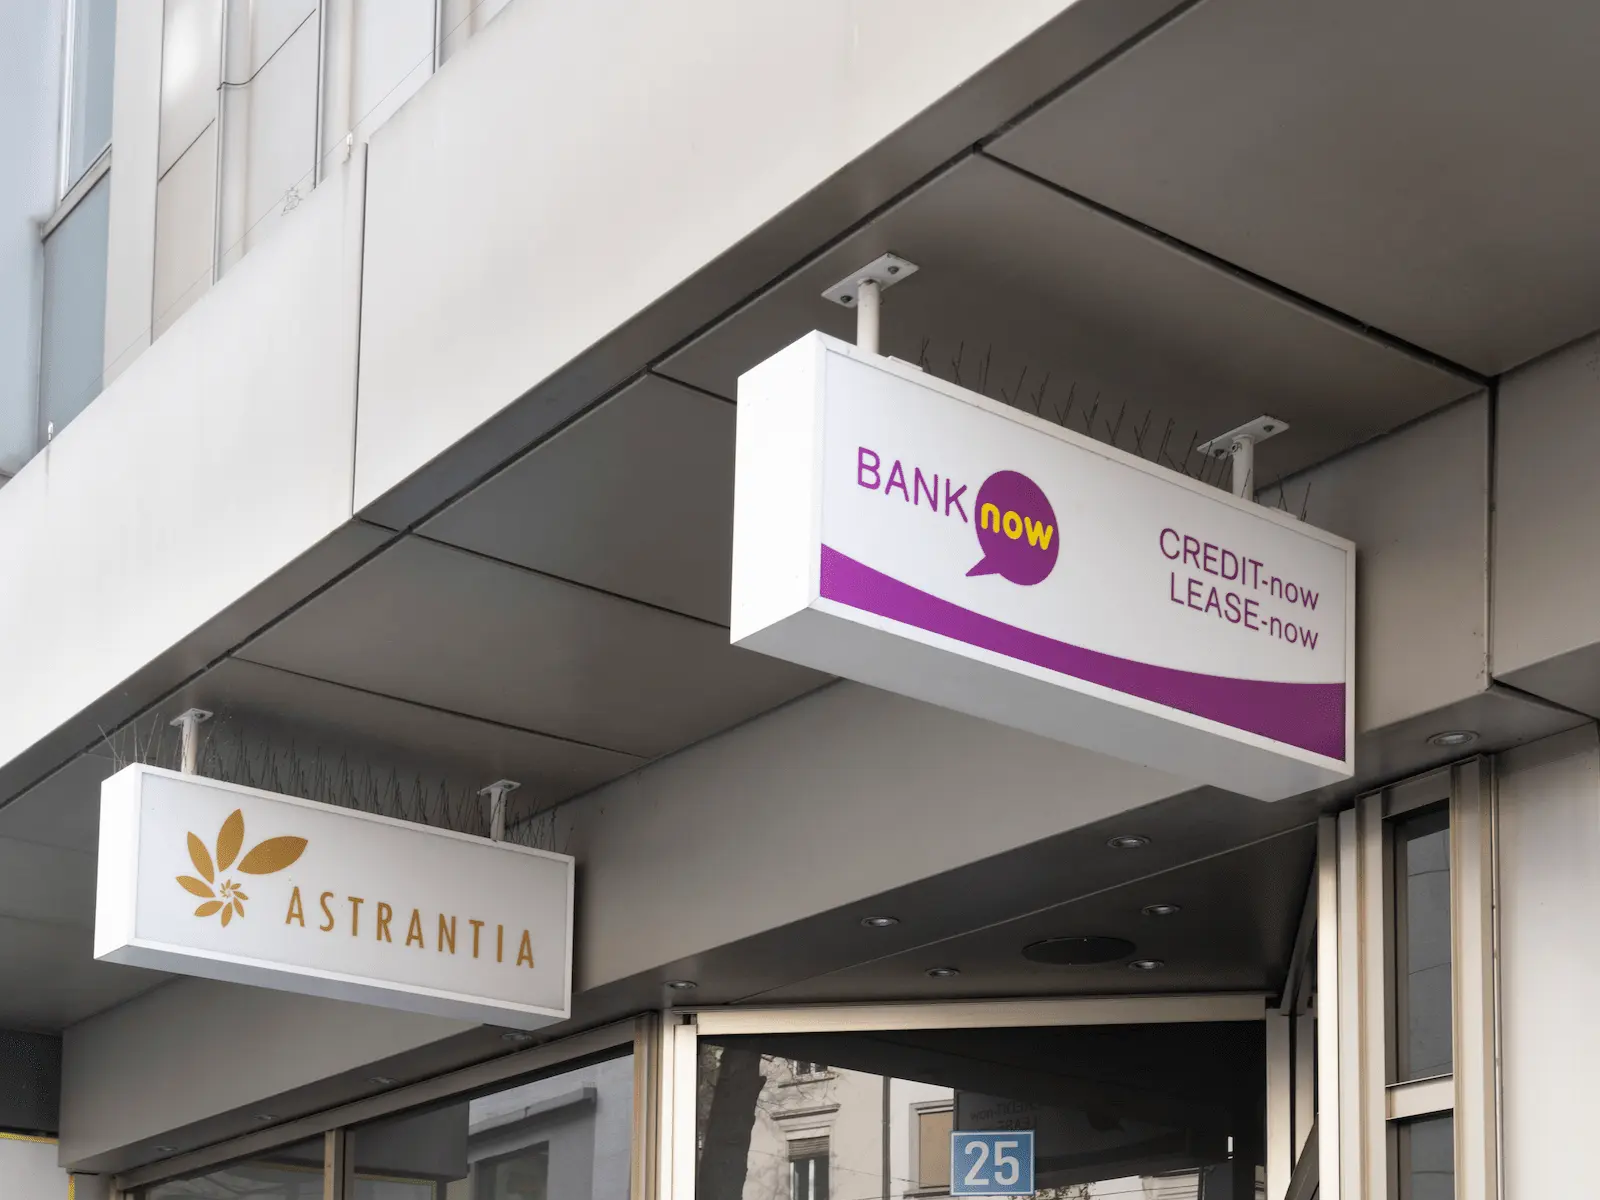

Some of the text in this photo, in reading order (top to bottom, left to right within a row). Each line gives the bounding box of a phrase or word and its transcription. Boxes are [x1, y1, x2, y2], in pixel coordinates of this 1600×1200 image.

[856, 446, 968, 523] BANK
[980, 502, 1053, 551] now
[1159, 527, 1320, 610] CREDIT-now
[1169, 572, 1319, 651] LEASE-now
[285, 886, 535, 969] ASTRANTIA
[963, 1139, 1021, 1187] 25
